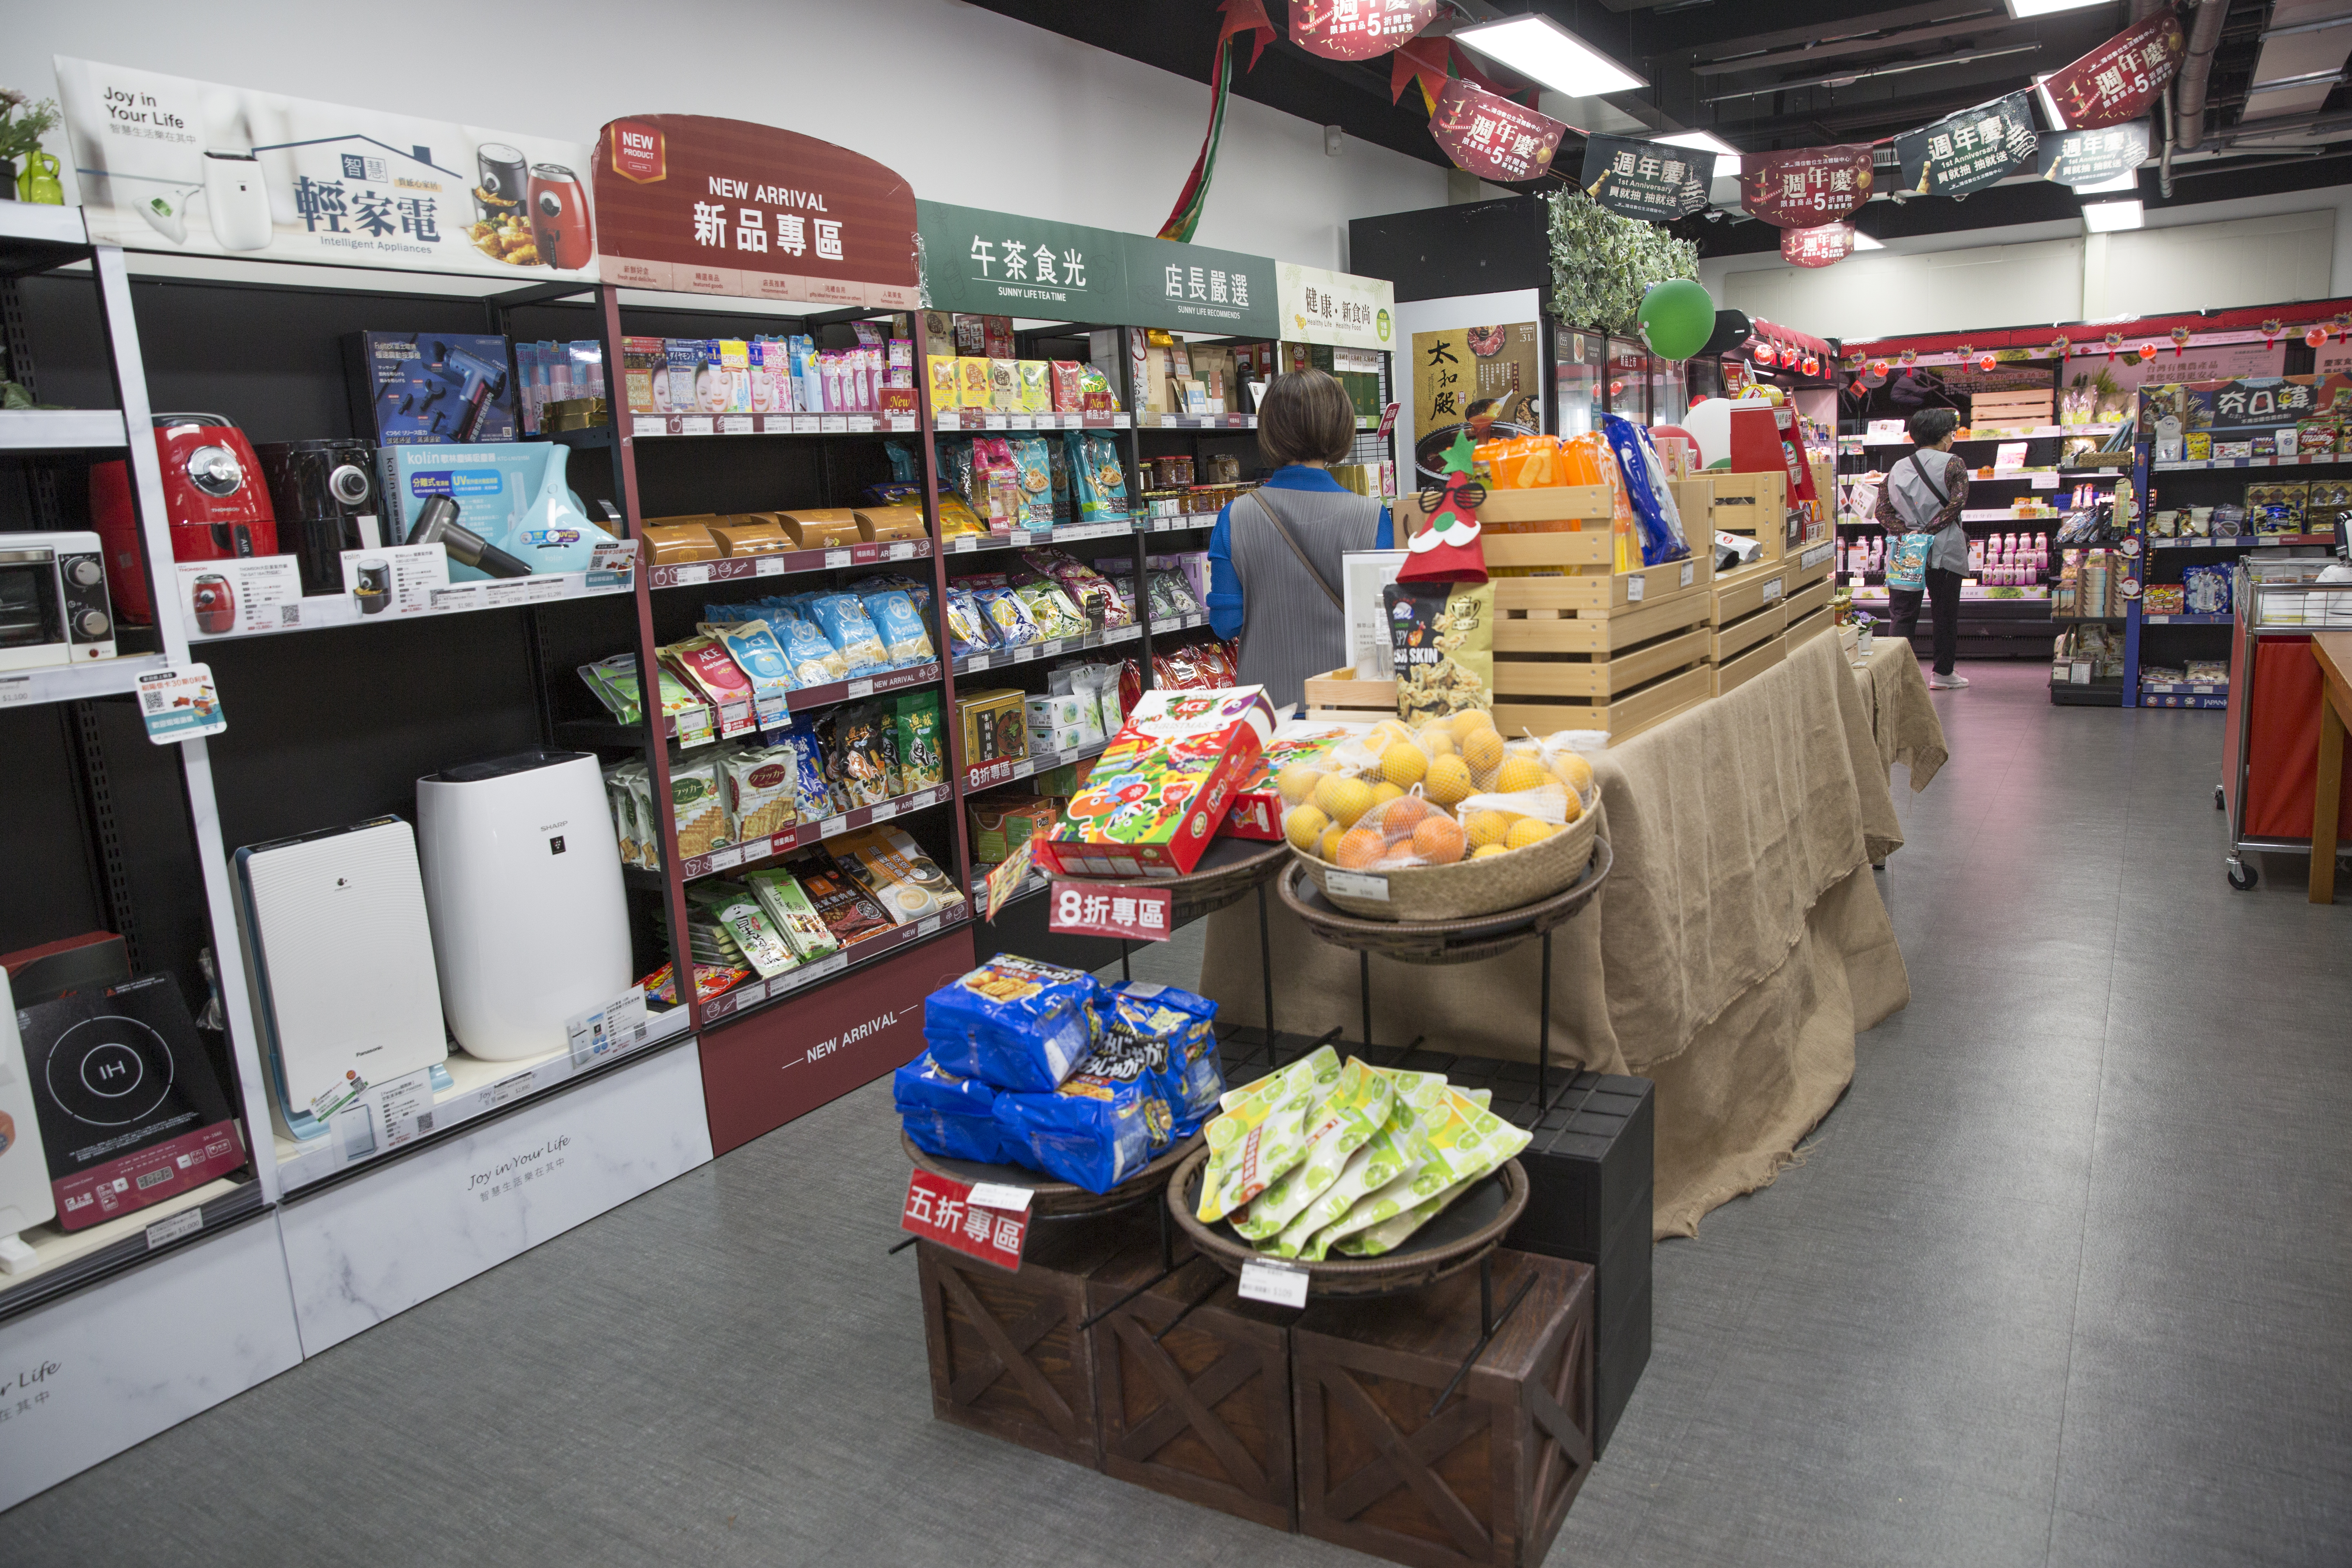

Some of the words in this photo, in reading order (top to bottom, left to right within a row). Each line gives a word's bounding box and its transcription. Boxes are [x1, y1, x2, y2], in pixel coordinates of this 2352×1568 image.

[1301, 10, 1334, 30] ANNIVERSARY
[1367, 12, 1381, 36] 5
[1383, 13, 1412, 26] 折開跑
[1330, 21, 1365, 35] 限量商品
[2094, 42, 2167, 100] 週年慶
[2134, 73, 2149, 93] 5
[104, 87, 134, 106] Joy
[140, 92, 156, 107] in
[2075, 91, 2101, 116] ANNIVERSARY
[2103, 85, 2136, 109] 限量商品
[106, 104, 147, 122] Your
[154, 112, 184, 128] Life
[110, 123, 196, 144] 智慧生活樂在其中
[623, 131, 654, 150] NEW
[1467, 114, 1537, 160] 週年慶
[1928, 115, 2005, 162] 週年慶
[1462, 137, 1491, 154] 限量商品
[2013, 141, 2028, 155] Happy
[2017, 144, 2036, 158] Birthday
[2062, 131, 2124, 158] 週年慶
[624, 148, 654, 160] PRODUCT
[1490, 146, 1506, 164] 5
[1942, 159, 1953, 168] 1st
[1955, 145, 1998, 165] Anniversary
[2079, 153, 2117, 163] Anniversary
[344, 156, 386, 180] 智慧
[1505, 155, 1528, 169] 折開跑
[1612, 152, 1686, 186] 週年慶
[1937, 164, 1971, 184] 買就抽
[1974, 150, 2008, 172] 抽就送
[1630, 180, 1673, 194] Anniversary
[1782, 166, 1852, 200] 週年慶
[709, 176, 748, 200] NEW
[755, 184, 828, 212] ARRIVAL
[1609, 186, 1642, 201] 買就抽
[1644, 192, 1677, 207] 抽就送
[1753, 189, 1783, 202] ANNIVERSARY
[1814, 192, 1826, 211] 5
[1828, 194, 1852, 203] 折開跑
[292, 176, 441, 243] 輕家電
[1781, 198, 1812, 208] 限量商品
[694, 201, 844, 260] 新品專區
[321, 236, 374, 249] Intelligent
[378, 242, 432, 254] Appliances
[1803, 233, 1844, 252] 週年慶
[1821, 247, 1829, 258] 5
[971, 235, 1086, 286] 午茶食光
[695, 272, 720, 282] 精選商品
[763, 279, 786, 288] 店長推薦
[1165, 263, 1249, 307] 店長嚴選
[882, 291, 902, 299] 人氣美食
[998, 287, 1022, 297] SUNNY
[1024, 290, 1038, 299] LIFE
[1038, 291, 1050, 300] TEA
[1051, 292, 1066, 302] TIME
[1178, 305, 1195, 315] SUNNY
[1196, 307, 1207, 316] LIFE
[1207, 309, 1240, 319] RECOMMENDS
[1307, 318, 1323, 327] Healthy
[1336, 321, 1351, 330] Healthy
[1352, 323, 1361, 331] Food
[722, 355, 745, 365] ビタミンC
[1620, 355, 1637, 368] 新品上市
[627, 383, 650, 393] GOLD
[1428, 340, 1459, 421] 太和殿
[890, 396, 911, 408] New
[1090, 398, 1106, 409] New
[2218, 385, 2310, 415] 夯日韓
[1086, 409, 1110, 421] 新品上市
[1386, 409, 1397, 419] 店長
[407, 452, 440, 465] kolin
[387, 457, 395, 490] kolin
[241, 538, 249, 552] AIR
[856, 549, 876, 558] 暢銷商品
[745, 636, 767, 648] ACE
[700, 648, 721, 662] ACE
[1410, 648, 1438, 663] SKIN
[703, 661, 713, 671] Fruit
[713, 657, 732, 668] Gummies
[874, 679, 888, 689] NEW
[889, 674, 915, 686] ARRIVAL
[1178, 701, 1206, 712] ACE
[1148, 722, 1209, 731] CHRISTMAS
[984, 722, 993, 761] 麻辣鍋底
[751, 770, 785, 782] クラッカー
[970, 760, 1011, 787] 8折專區
[540, 820, 568, 832] SHARP
[774, 835, 795, 846] 明星商品
[813, 889, 857, 909] 元氣豬肉條
[1058, 890, 1165, 929] 8折專區
[902, 928, 915, 939] NEW
[806, 1038, 837, 1063] NEW
[842, 1011, 898, 1048] ARRIVAL
[356, 1045, 383, 1057] Panasonic
[97, 1060, 126, 1081] IH
[478, 1090, 492, 1102] Joy
[515, 1084, 530, 1094] $2,890
[468, 1171, 491, 1190] Joy
[496, 1162, 512, 1176] in
[513, 1147, 543, 1167] Your
[548, 1135, 571, 1153] Life
[480, 1157, 565, 1202] 智慧生活樂在其中
[178, 1220, 200, 1233] $1,000
[905, 1185, 1024, 1256] 五折專區
[19, 1359, 62, 1389] Life
